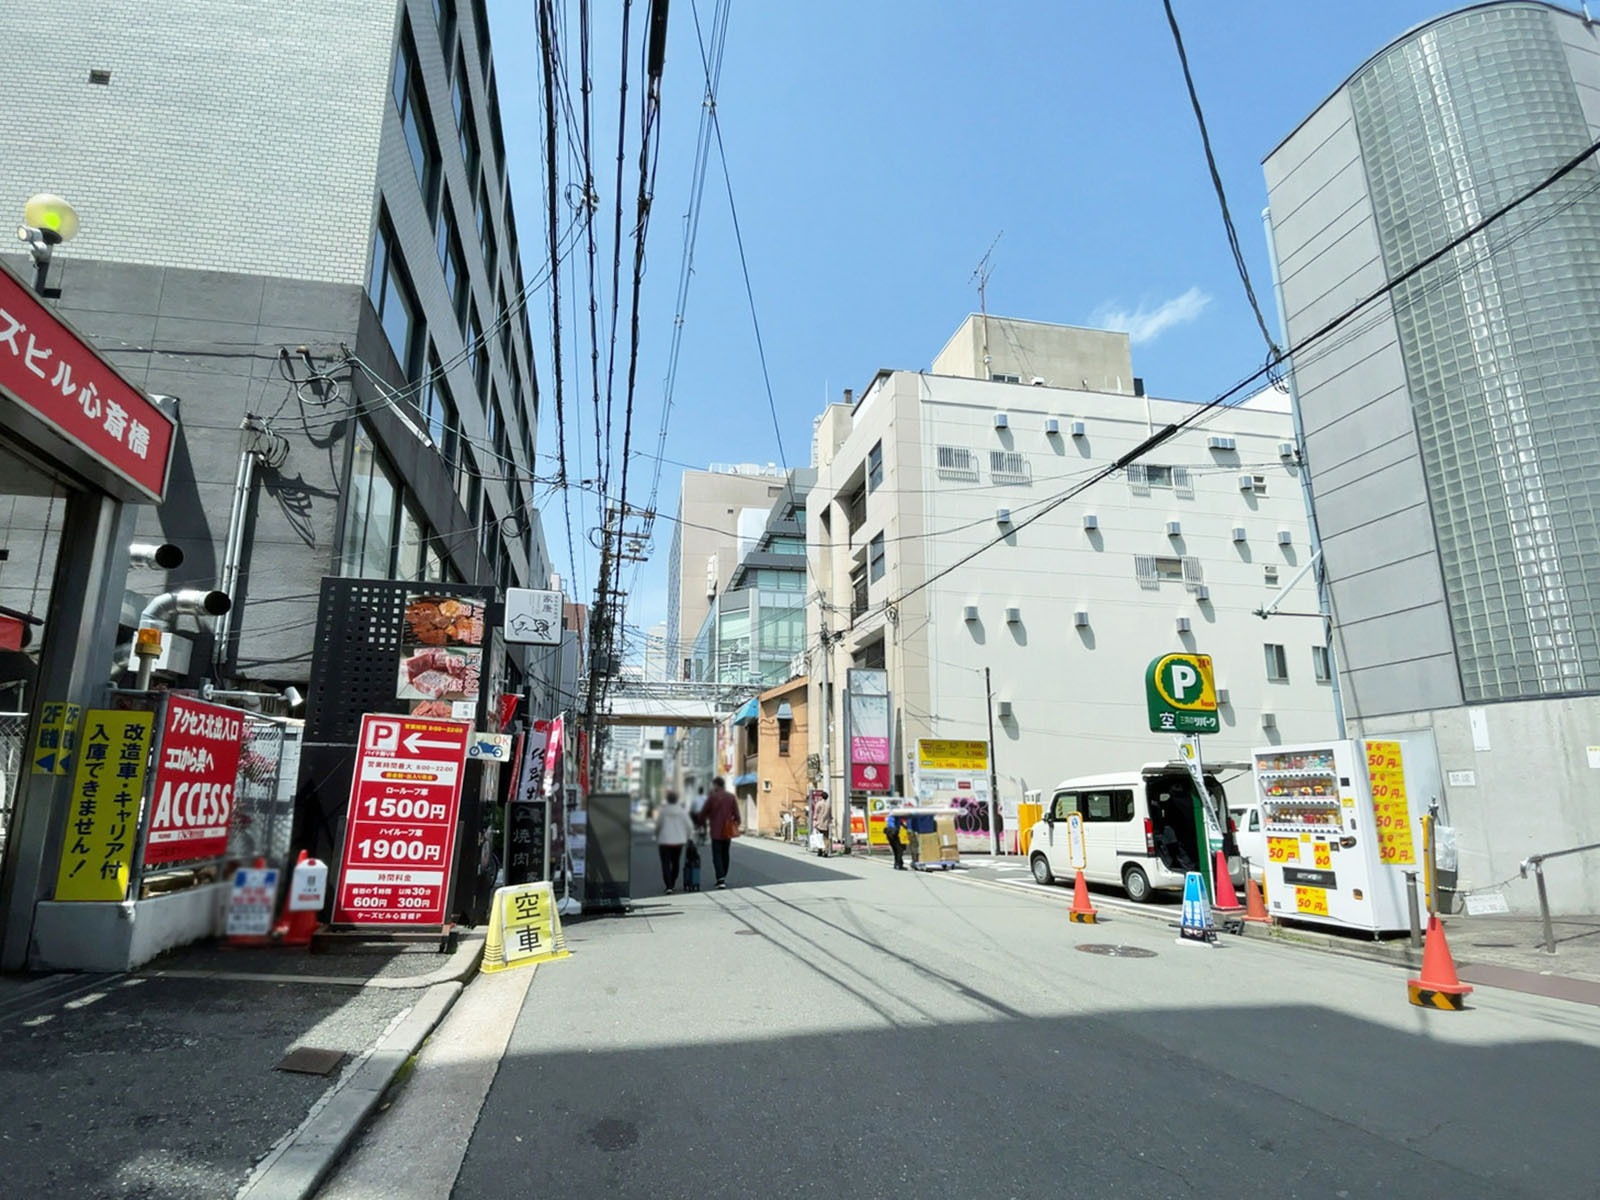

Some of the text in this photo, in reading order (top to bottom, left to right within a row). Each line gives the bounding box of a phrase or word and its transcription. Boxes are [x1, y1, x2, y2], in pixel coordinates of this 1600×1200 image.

[1171, 664, 1197, 700] P
[42, 705, 63, 724] 2F
[170, 706, 240, 742] アクセス北出入口
[1159, 712, 1177, 730] 空
[372, 724, 393, 747] P
[494, 734, 509, 745] OK
[100, 723, 146, 880] 改造車・キャリア付
[151, 780, 232, 829] ACCESS
[364, 797, 447, 820] 1500円
[379, 828, 424, 837] ハイルーフ車
[358, 839, 441, 861] 1900円
[1315, 855, 1330, 866] 60
[378, 872, 412, 882] 時間料金
[353, 896, 431, 908] 600円 300円
[514, 892, 542, 953] 空車
